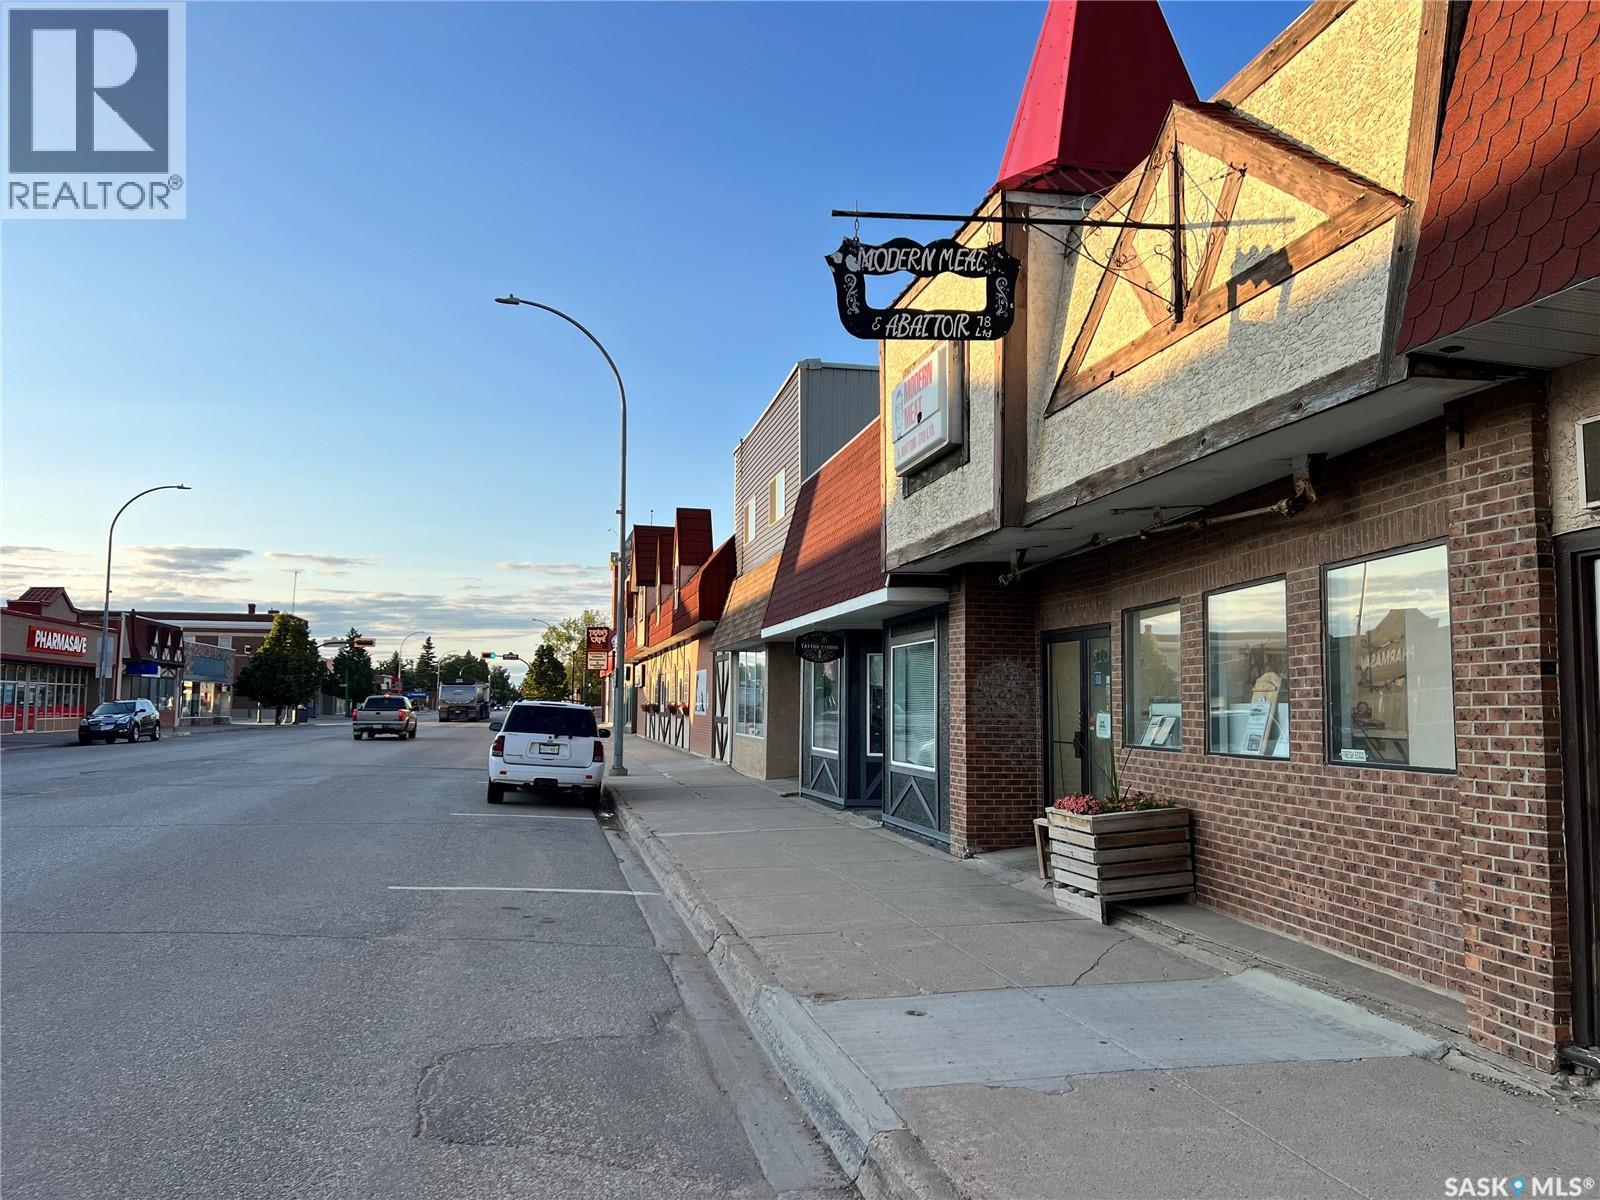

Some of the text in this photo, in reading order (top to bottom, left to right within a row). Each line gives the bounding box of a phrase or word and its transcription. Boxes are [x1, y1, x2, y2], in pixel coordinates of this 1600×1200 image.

[858, 248, 937, 272] MODERN
[885, 313, 971, 338] ABATTOIR
[976, 315, 992, 327] 78
[904, 360, 933, 406] MODERN
[904, 395, 922, 431] MEAT
[34, 629, 87, 653] PHARMASAVE
